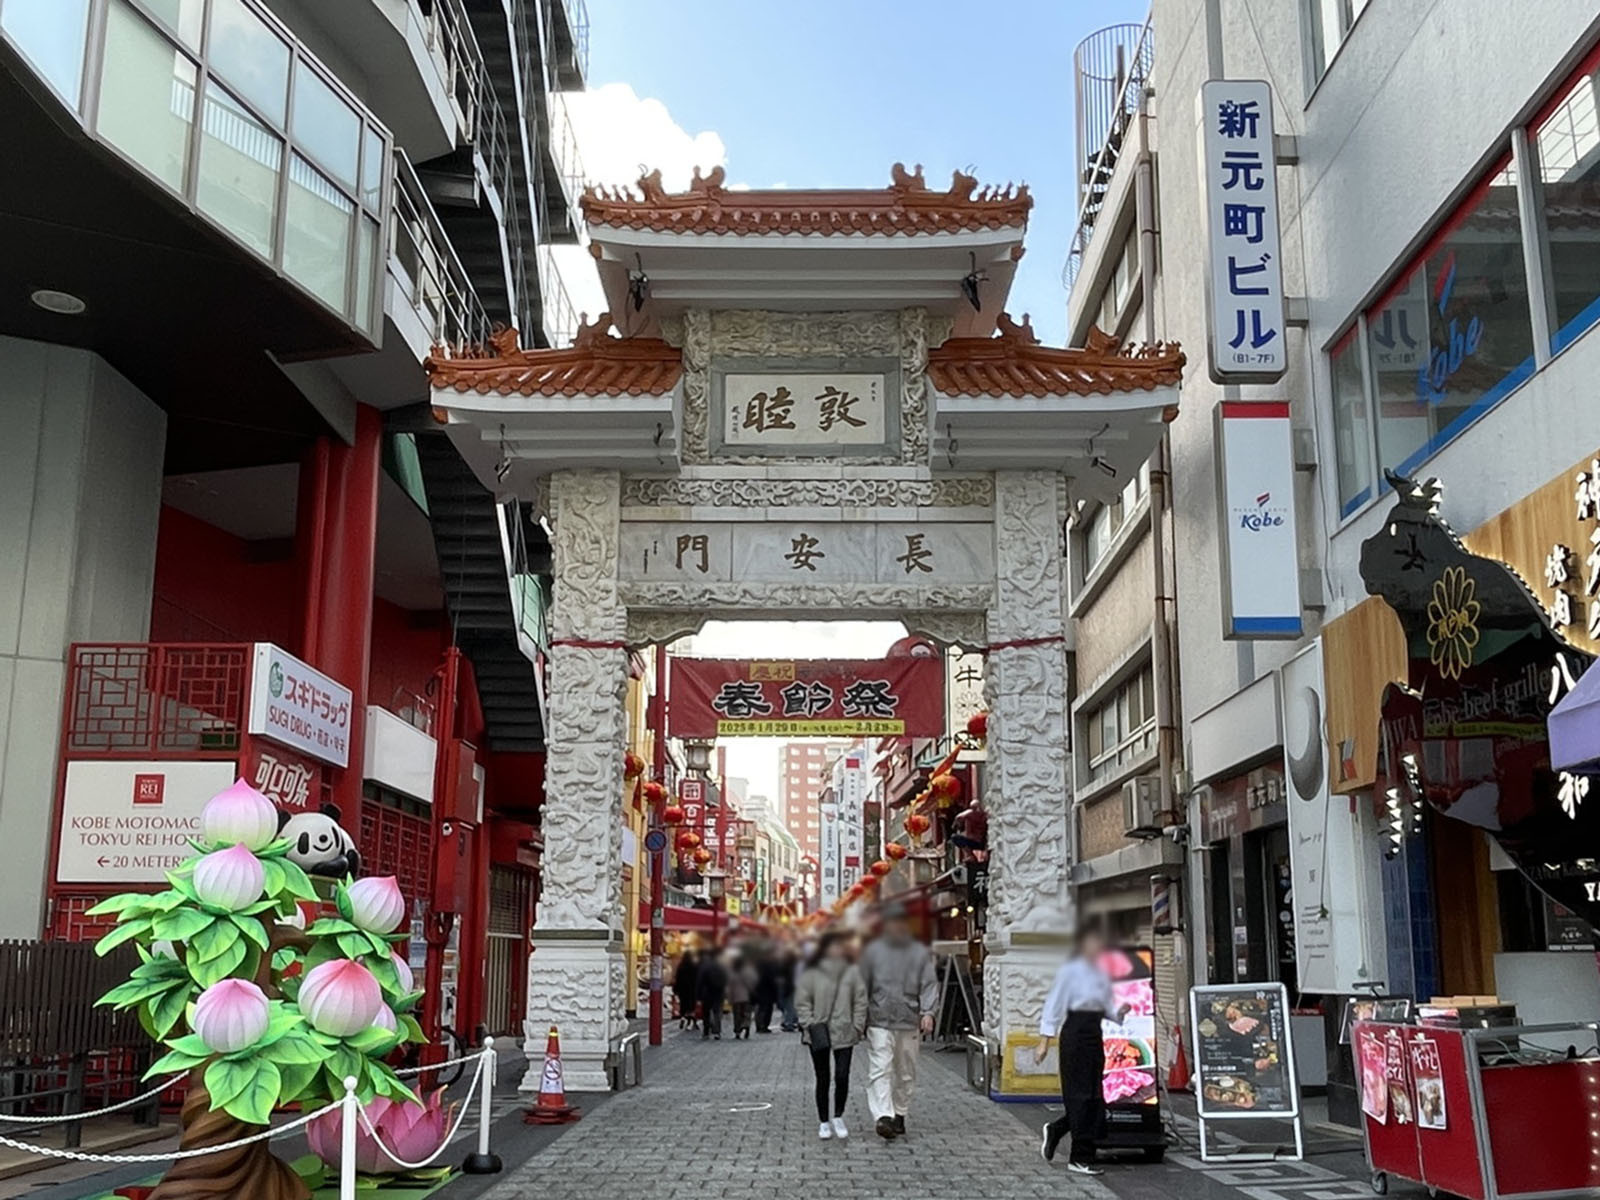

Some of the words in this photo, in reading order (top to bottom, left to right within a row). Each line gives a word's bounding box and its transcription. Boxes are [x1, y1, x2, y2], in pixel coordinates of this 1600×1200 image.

[1218, 100, 1277, 349] 新元町ビル
[1232, 353, 1275, 364] (B1-7F)
[1241, 512, 1284, 532] Kobe
[285, 675, 348, 727] スギドラッグ
[269, 706, 289, 731] SUGI
[290, 715, 312, 739] DRUG
[140, 784, 158, 795] REI
[72, 817, 111, 829] KOBE
[80, 833, 131, 846] TOKYU
[136, 833, 157, 846] REI
[162, 833, 208, 846] HOTE
[113, 856, 128, 868] 20
